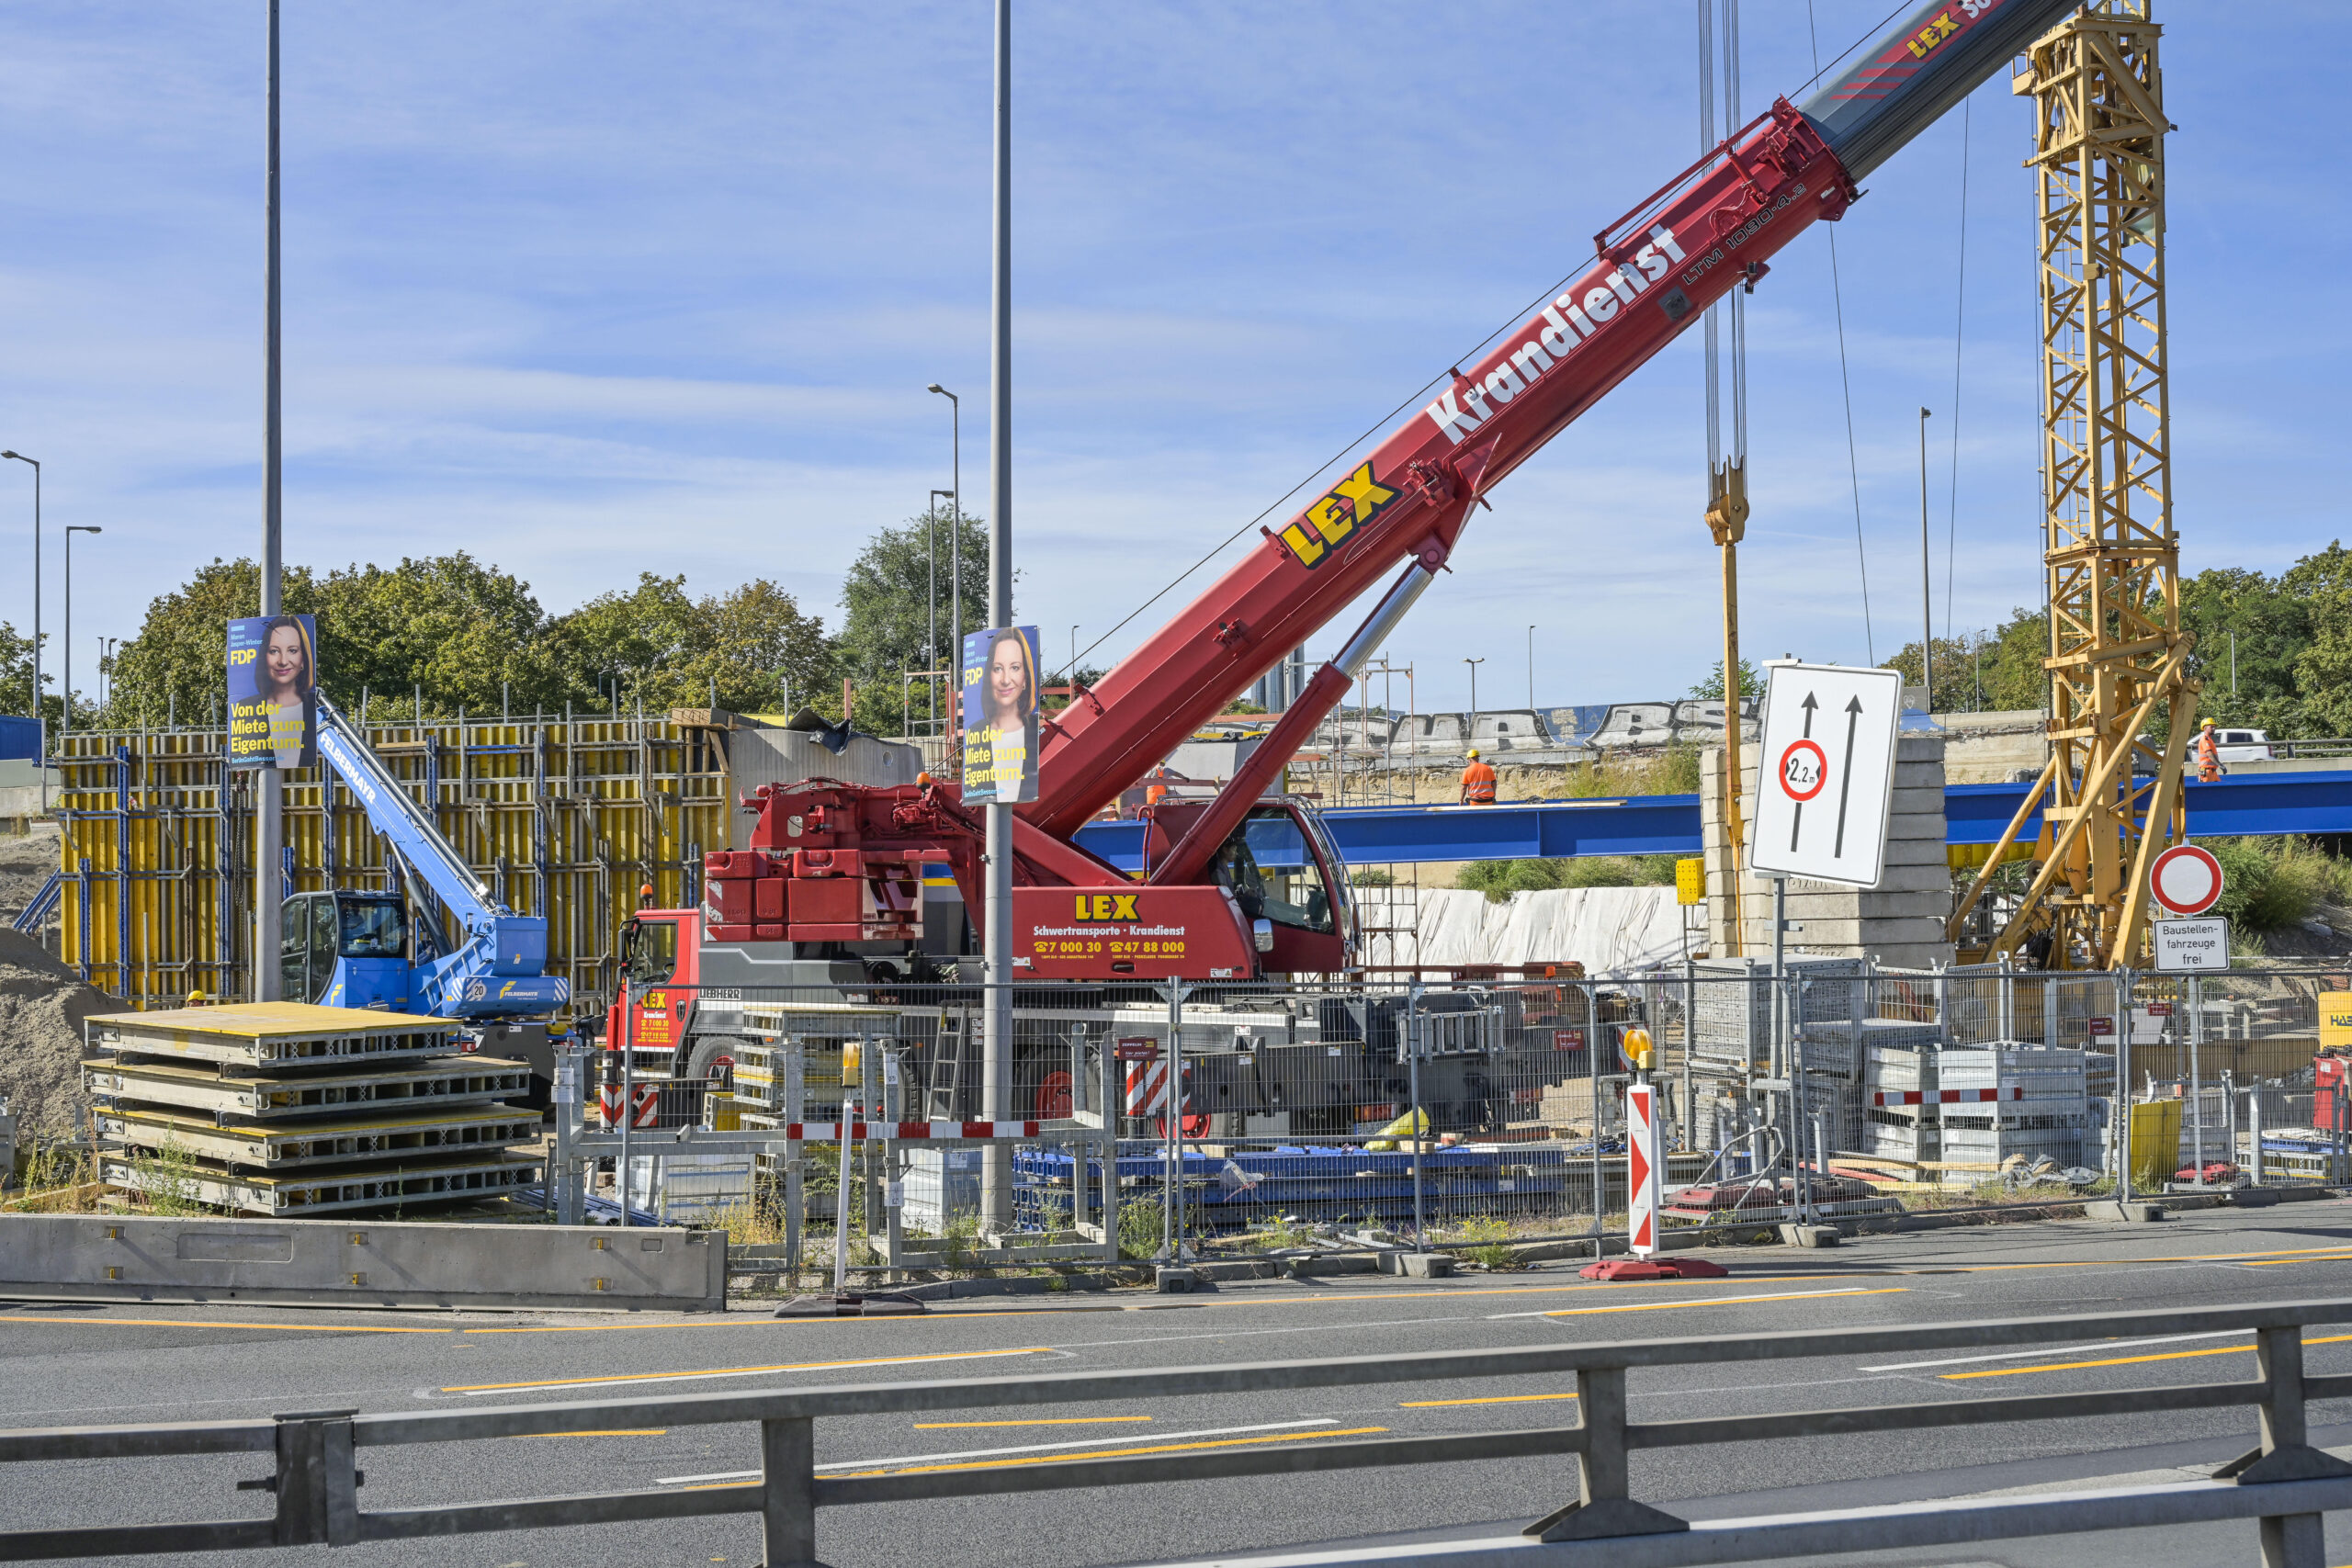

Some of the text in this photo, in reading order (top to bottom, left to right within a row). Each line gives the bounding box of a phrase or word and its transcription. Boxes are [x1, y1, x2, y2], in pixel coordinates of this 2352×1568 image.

[1905, 11, 1964, 60] LEX
[1682, 248, 1724, 285] LTM
[1425, 222, 1687, 446] Krandienst
[1279, 460, 1404, 570] LEX
[231, 649, 257, 666] FDP
[965, 667, 983, 687] FDP
[231, 700, 283, 717] Von der
[231, 719, 305, 735] Miete zum
[965, 725, 1004, 746] Von der
[231, 736, 305, 754] Eigentum.
[965, 747, 1026, 765] Miete zum
[320, 731, 376, 804] FELBERMAYR
[965, 765, 1025, 787] Eigentum.
[1075, 894, 1143, 923] LEX
[1034, 924, 1185, 938] Schwertransporte Krandienst
[2163, 925, 2218, 935] Baustellen-
[1049, 942, 1102, 953] 7 000 30
[1124, 942, 1185, 953] 47 88 000
[2167, 940, 2215, 950] fahrzeuge
[2183, 953, 2202, 964] frei
[474, 986, 483, 995] 20
[699, 988, 741, 999] LIEBHERR
[643, 992, 667, 1010] LEX
